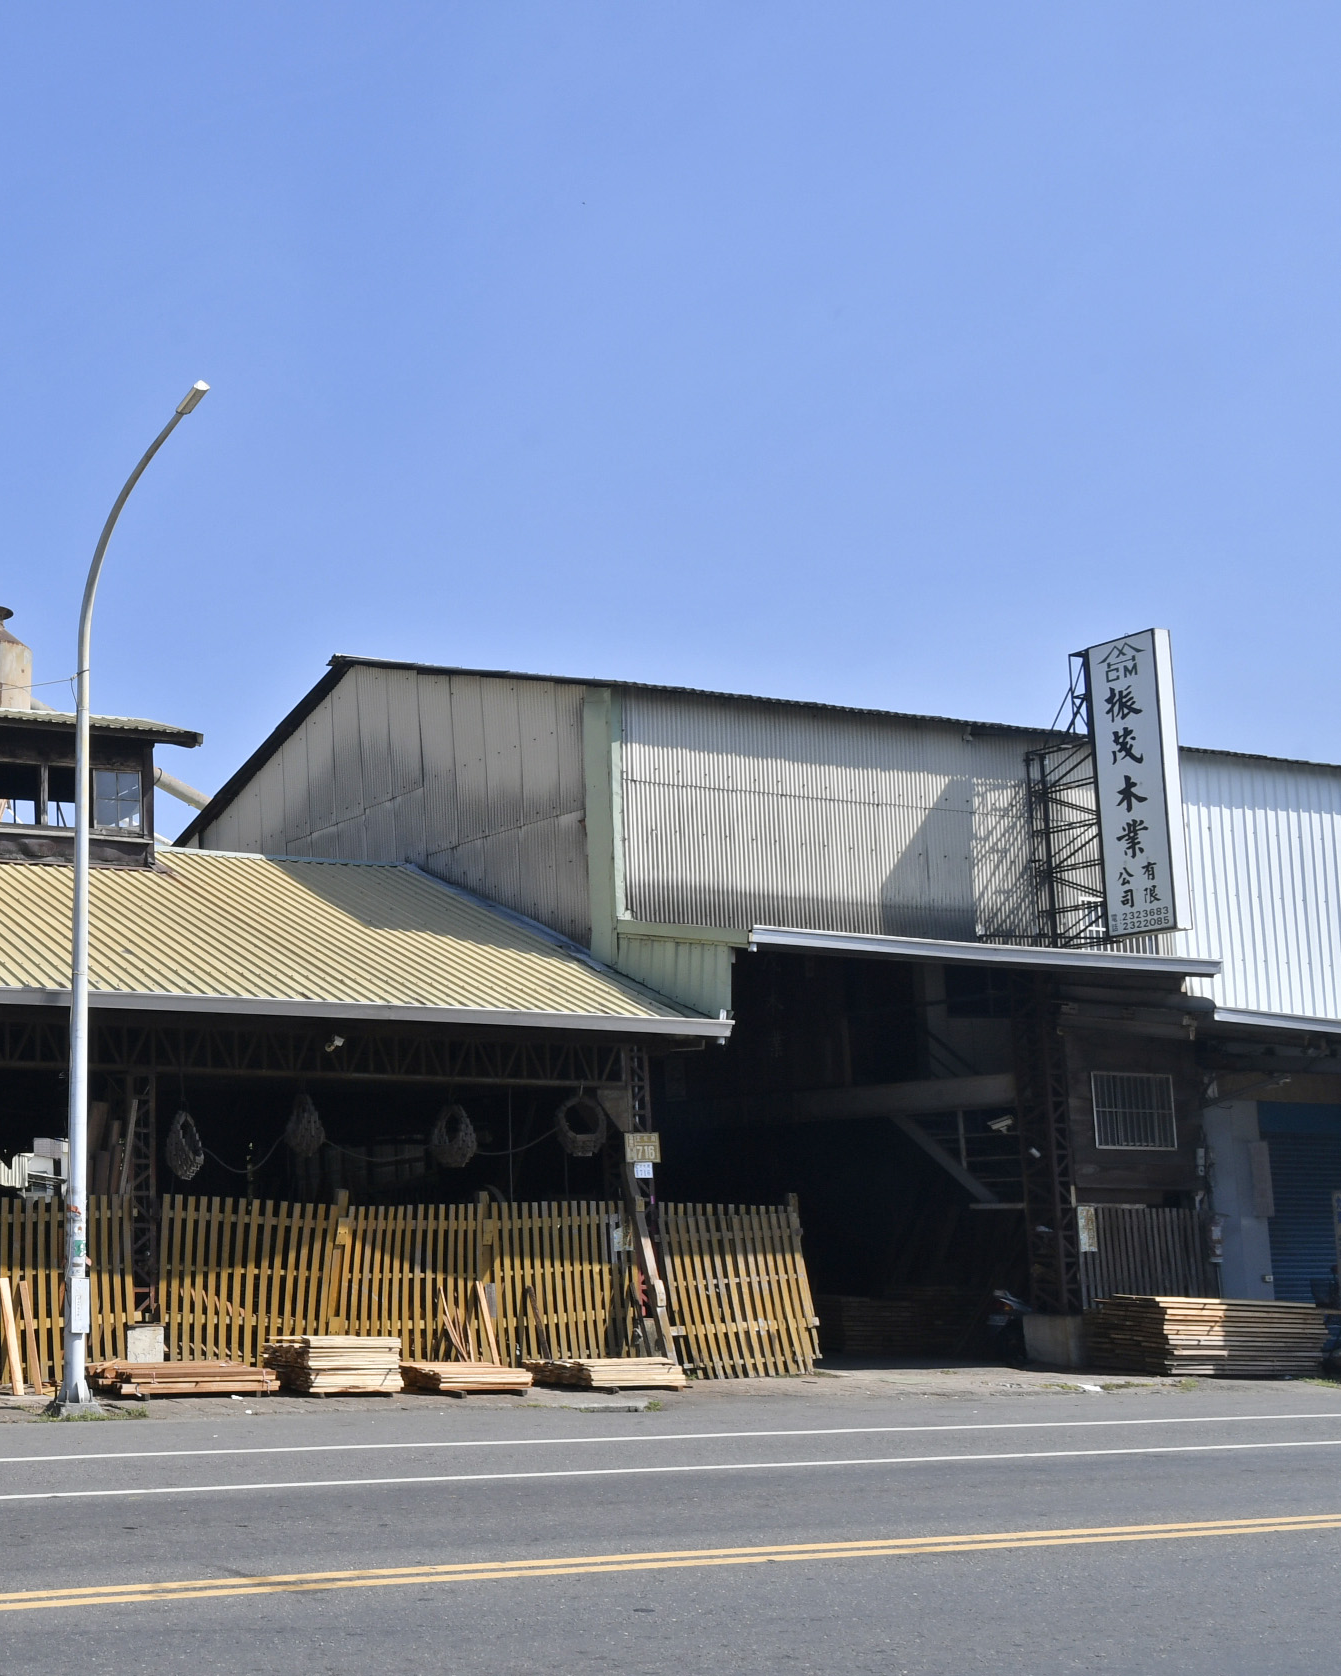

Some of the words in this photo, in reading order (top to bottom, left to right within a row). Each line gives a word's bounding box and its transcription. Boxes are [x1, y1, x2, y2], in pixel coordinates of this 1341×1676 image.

[1104, 685, 1149, 859] 振茂木業
[1117, 867, 1134, 908] 公司
[1141, 861, 1162, 904] 有限
[1121, 906, 1170, 921] 2323683
[1122, 915, 1171, 931] 2322085
[636, 1145, 656, 1160] 716
